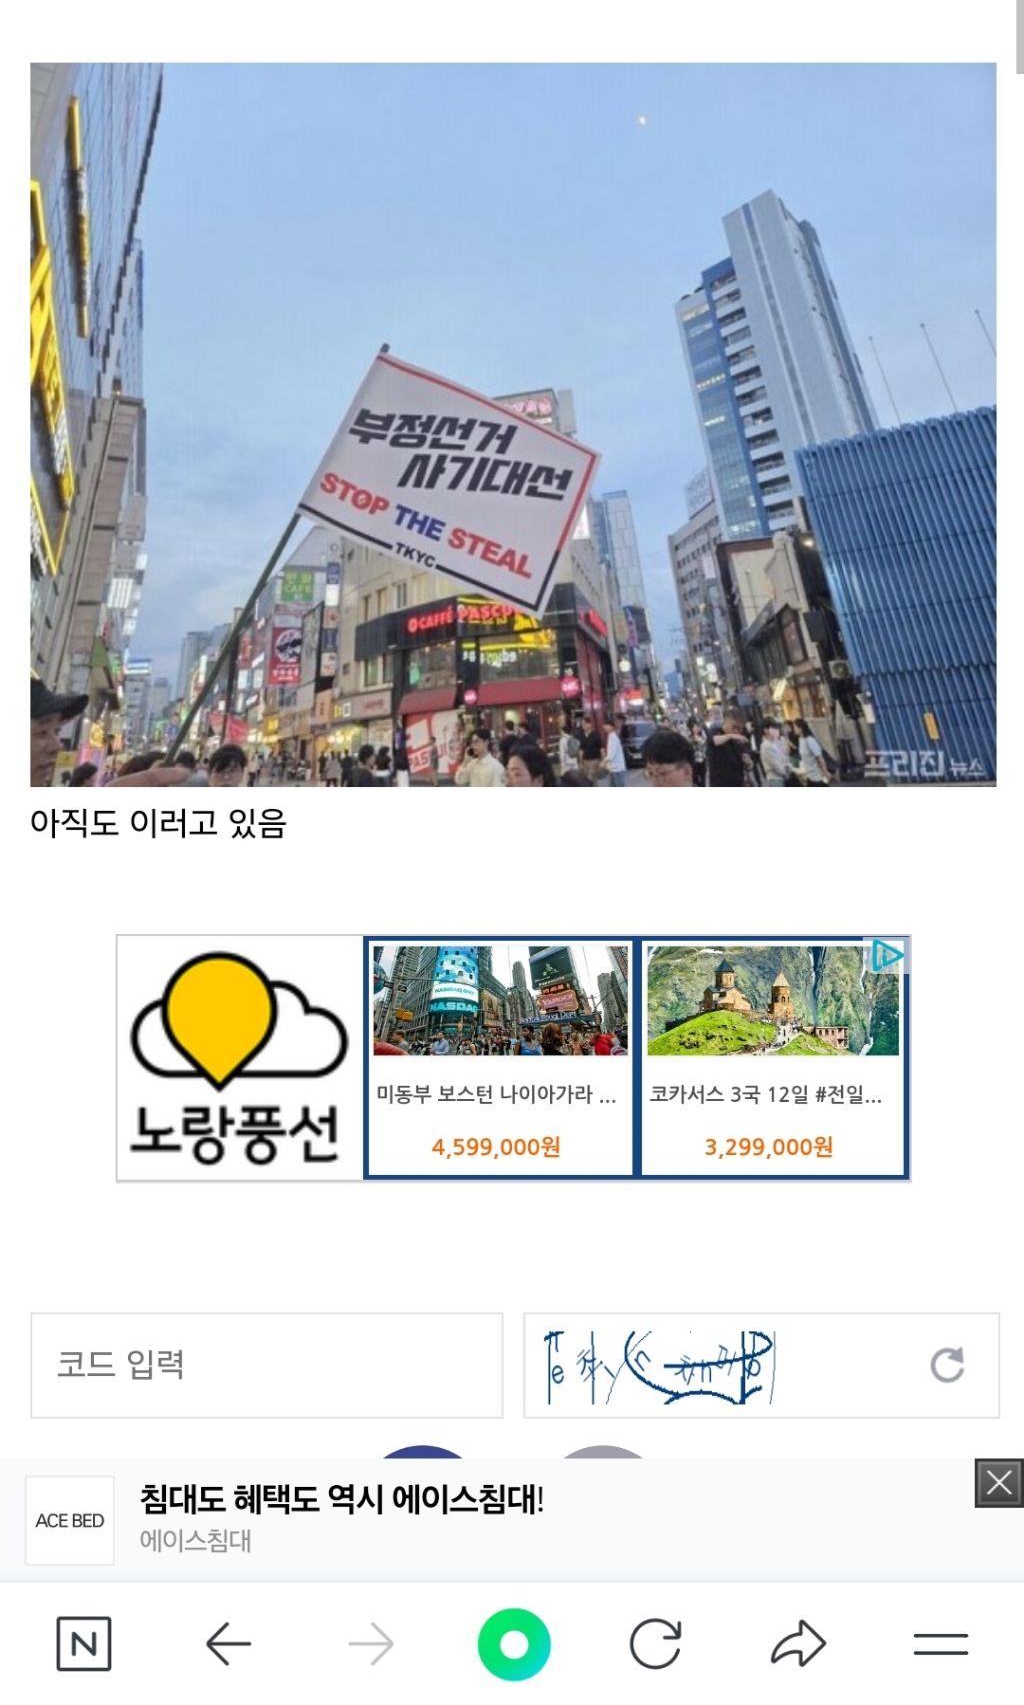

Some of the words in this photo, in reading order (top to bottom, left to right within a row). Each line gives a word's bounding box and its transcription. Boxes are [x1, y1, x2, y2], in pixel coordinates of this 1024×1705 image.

[348, 407, 518, 455] 부정선거
[397, 453, 574, 502] 사기대선
[320, 472, 390, 516] STOP
[395, 504, 447, 542] THE
[447, 527, 532, 579] STEAL
[396, 542, 437, 570] TKYC
[31, 809, 119, 839] 아직도
[131, 808, 217, 839] 이러고
[230, 809, 286, 839] 있음
[378, 1085, 432, 1104] 미동부
[438, 1085, 492, 1104] 보스턴
[501, 1085, 593, 1104] 나이아가라
[649, 1085, 724, 1104] 코카서스
[731, 1086, 761, 1105] 3국
[769, 1085, 808, 1104] 12일
[816, 1085, 881, 1104] #전일...
[130, 1105, 338, 1166] 노랑풍선
[432, 1136, 560, 1159] 4,599,000원
[705, 1136, 832, 1159] 3,299,000원
[58, 1352, 115, 1376] 코드
[128, 1350, 182, 1380] 입력
[141, 1484, 226, 1515] 침대도
[234, 1484, 320, 1515] 혜택도
[328, 1484, 382, 1515] 역시
[393, 1484, 543, 1515] 에이스침대!
[35, 1513, 68, 1528] ACE
[73, 1513, 104, 1527] BED
[141, 1529, 250, 1553] 에이스침대
